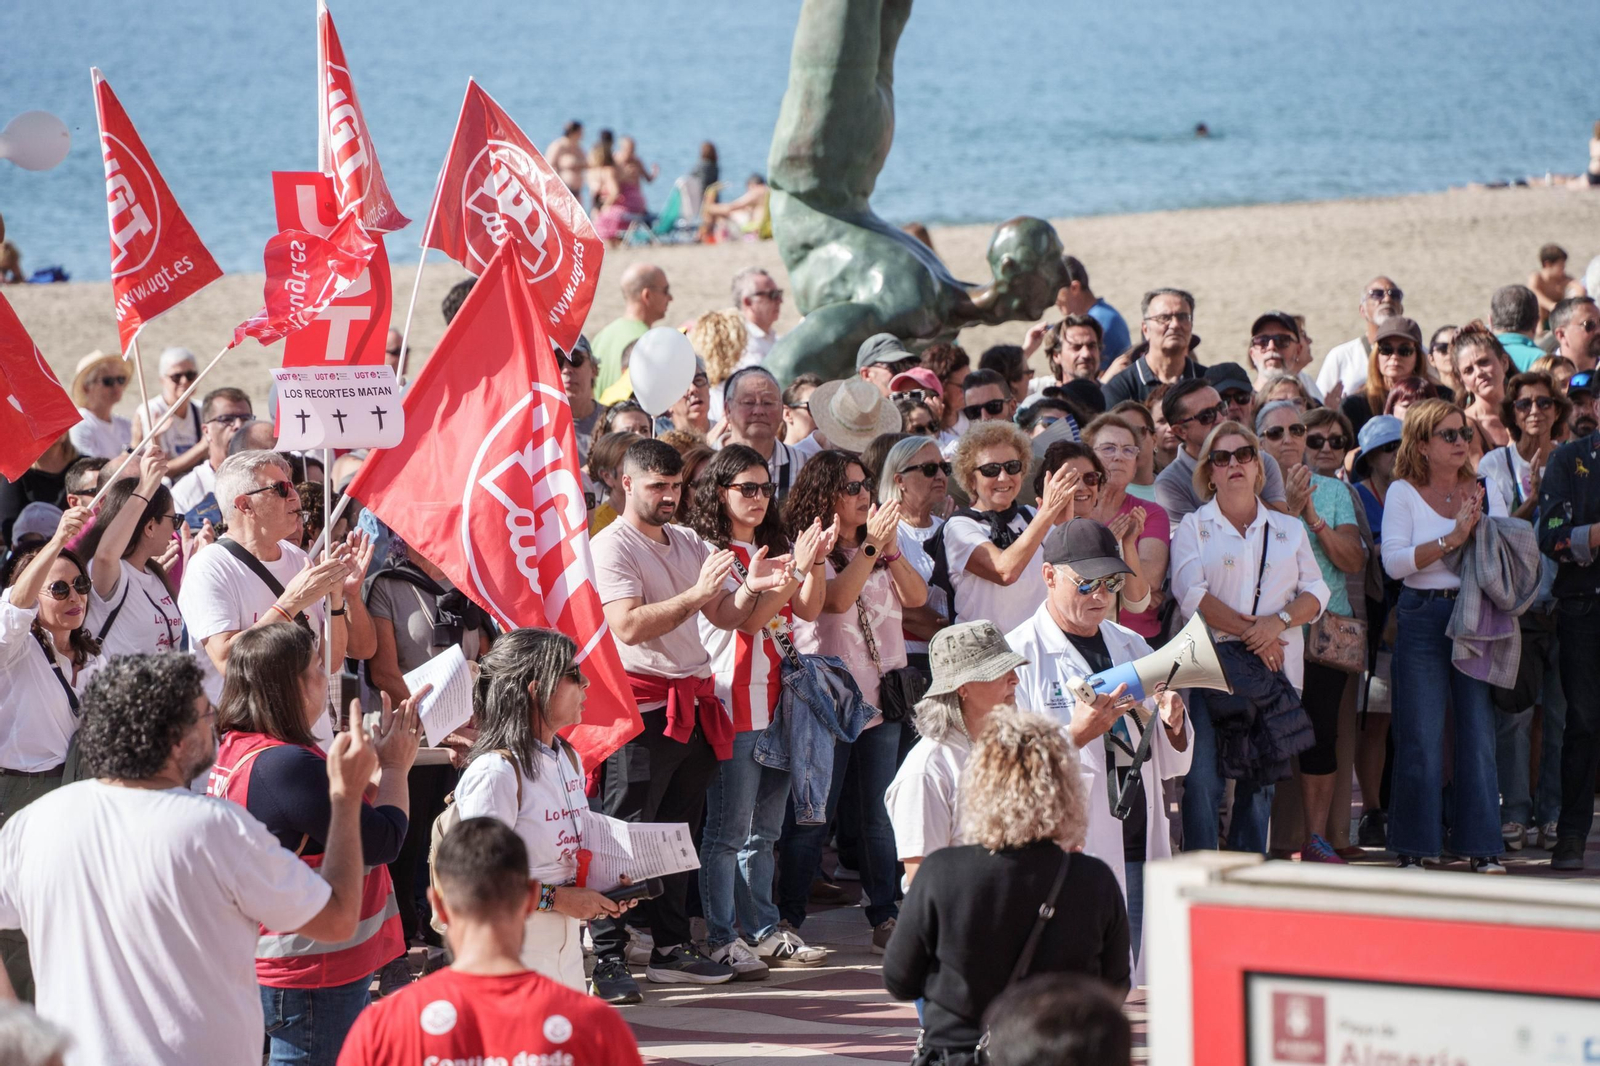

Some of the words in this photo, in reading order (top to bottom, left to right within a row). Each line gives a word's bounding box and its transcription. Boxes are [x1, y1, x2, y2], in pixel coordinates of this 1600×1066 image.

[295, 185, 372, 361] UT
[115, 255, 194, 322] www.ugt.es
[549, 238, 586, 328] www.ugt.es
[276, 373, 291, 381] UGT
[314, 373, 329, 381] UGT
[354, 371, 370, 379] UGT
[284, 389, 303, 398] LOS
[304, 388, 356, 399] RECORTES
[357, 386, 392, 397] MATAN
[566, 779, 579, 793] UGT
[545, 808, 560, 822] Lo
